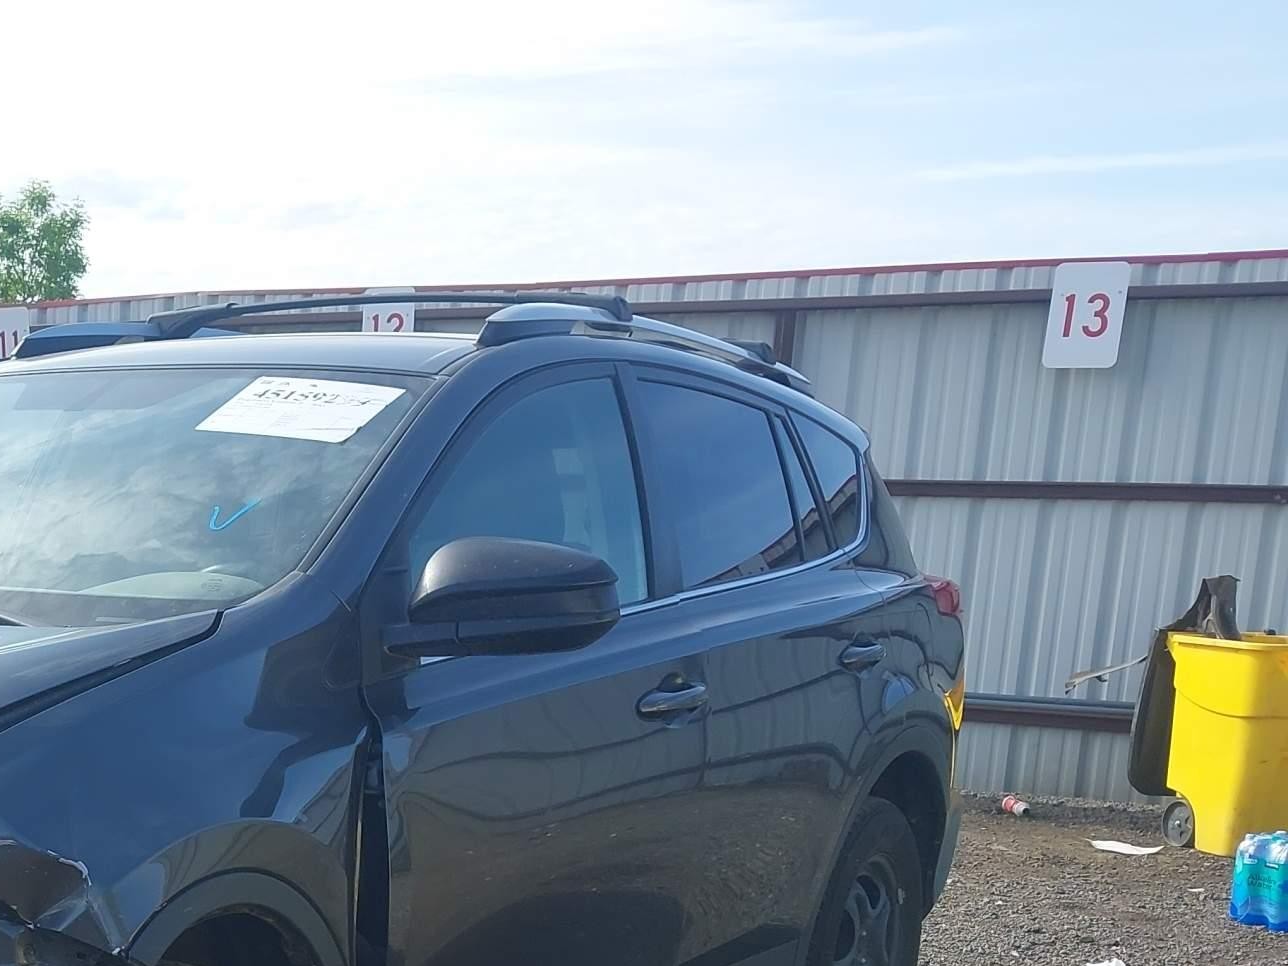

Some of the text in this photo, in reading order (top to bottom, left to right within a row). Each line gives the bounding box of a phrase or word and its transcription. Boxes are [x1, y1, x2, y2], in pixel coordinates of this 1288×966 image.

[372, 312, 404, 333] 12
[1063, 293, 1111, 338] 13
[0, 330, 19, 358] 11
